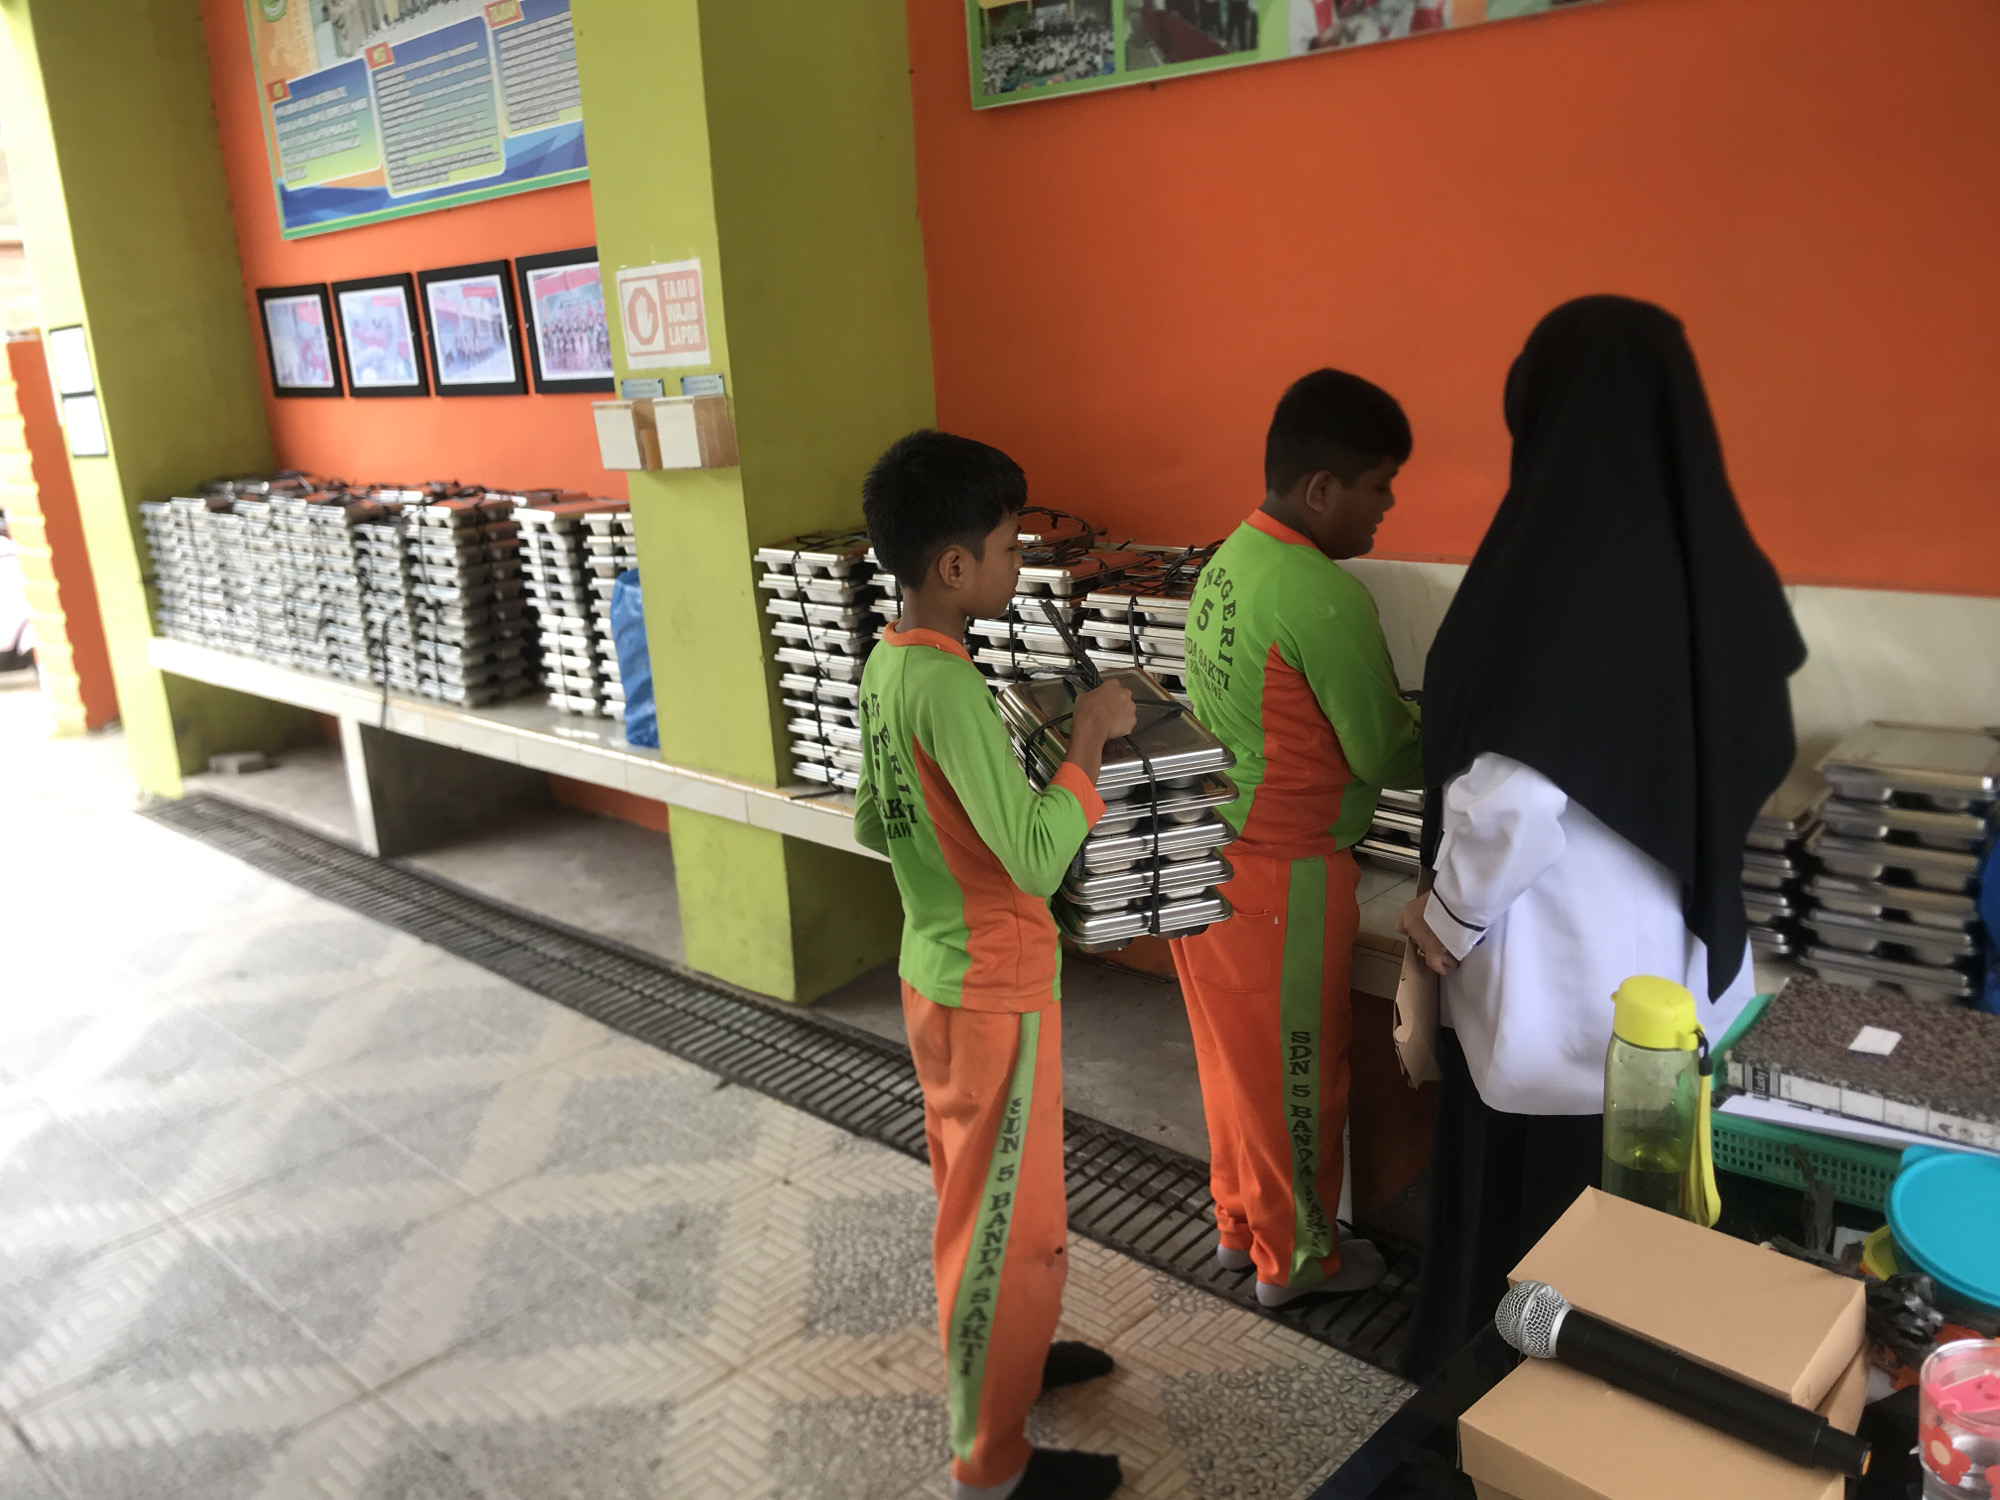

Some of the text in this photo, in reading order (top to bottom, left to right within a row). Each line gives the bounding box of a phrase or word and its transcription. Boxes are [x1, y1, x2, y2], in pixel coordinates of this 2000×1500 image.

[662, 278, 696, 300] TAMU
[665, 302, 698, 322] WAJIB
[668, 325, 701, 346] LAPOR
[1196, 598, 1214, 631] 5
[1203, 567, 1236, 667] NEGERI
[1289, 1031, 1312, 1075] SDN
[1292, 1085, 1311, 1099] 5
[1290, 1104, 1314, 1177] BANDA
[996, 1163, 1015, 1182] 5
[973, 1192, 1011, 1280] BANDA
[958, 1287, 991, 1377] SAKTI
